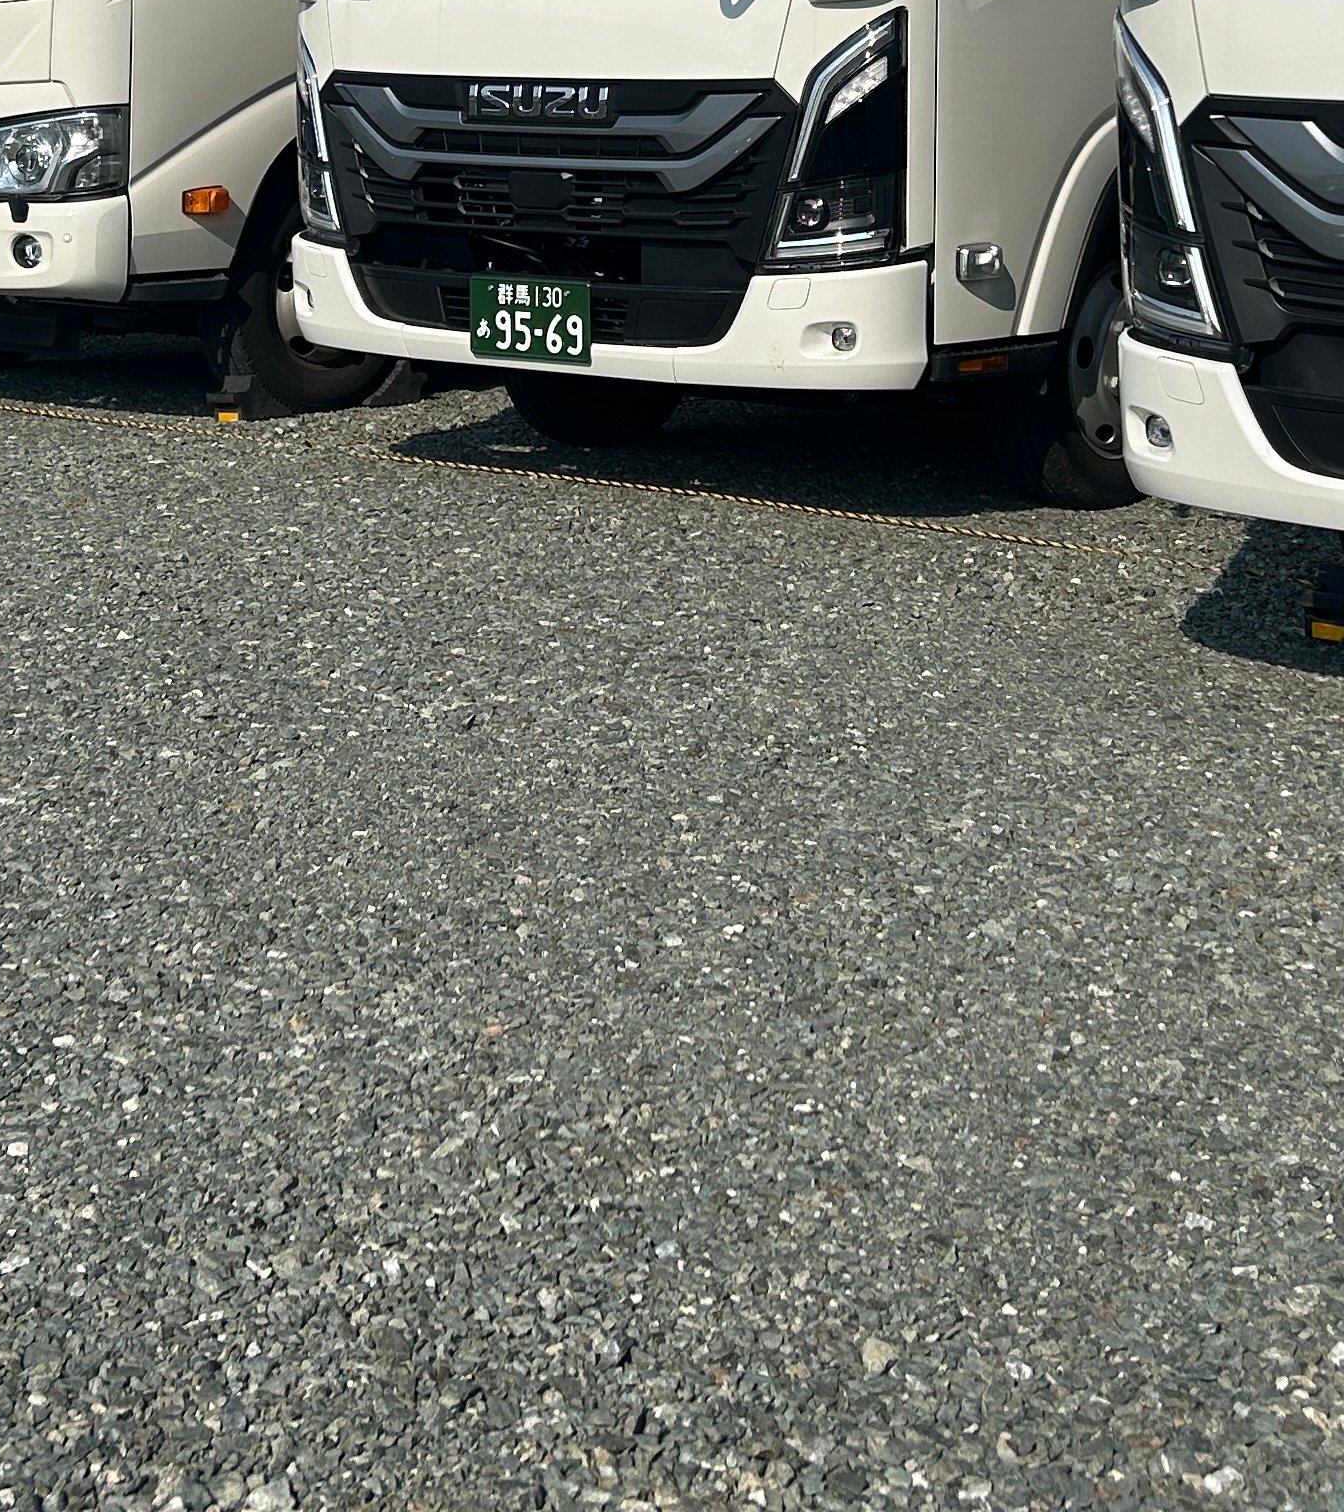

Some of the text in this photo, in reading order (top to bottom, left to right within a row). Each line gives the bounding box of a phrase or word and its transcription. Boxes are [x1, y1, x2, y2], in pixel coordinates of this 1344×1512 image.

[469, 84, 609, 120] ISUZU
[476, 310, 583, 356] あ 95-69
